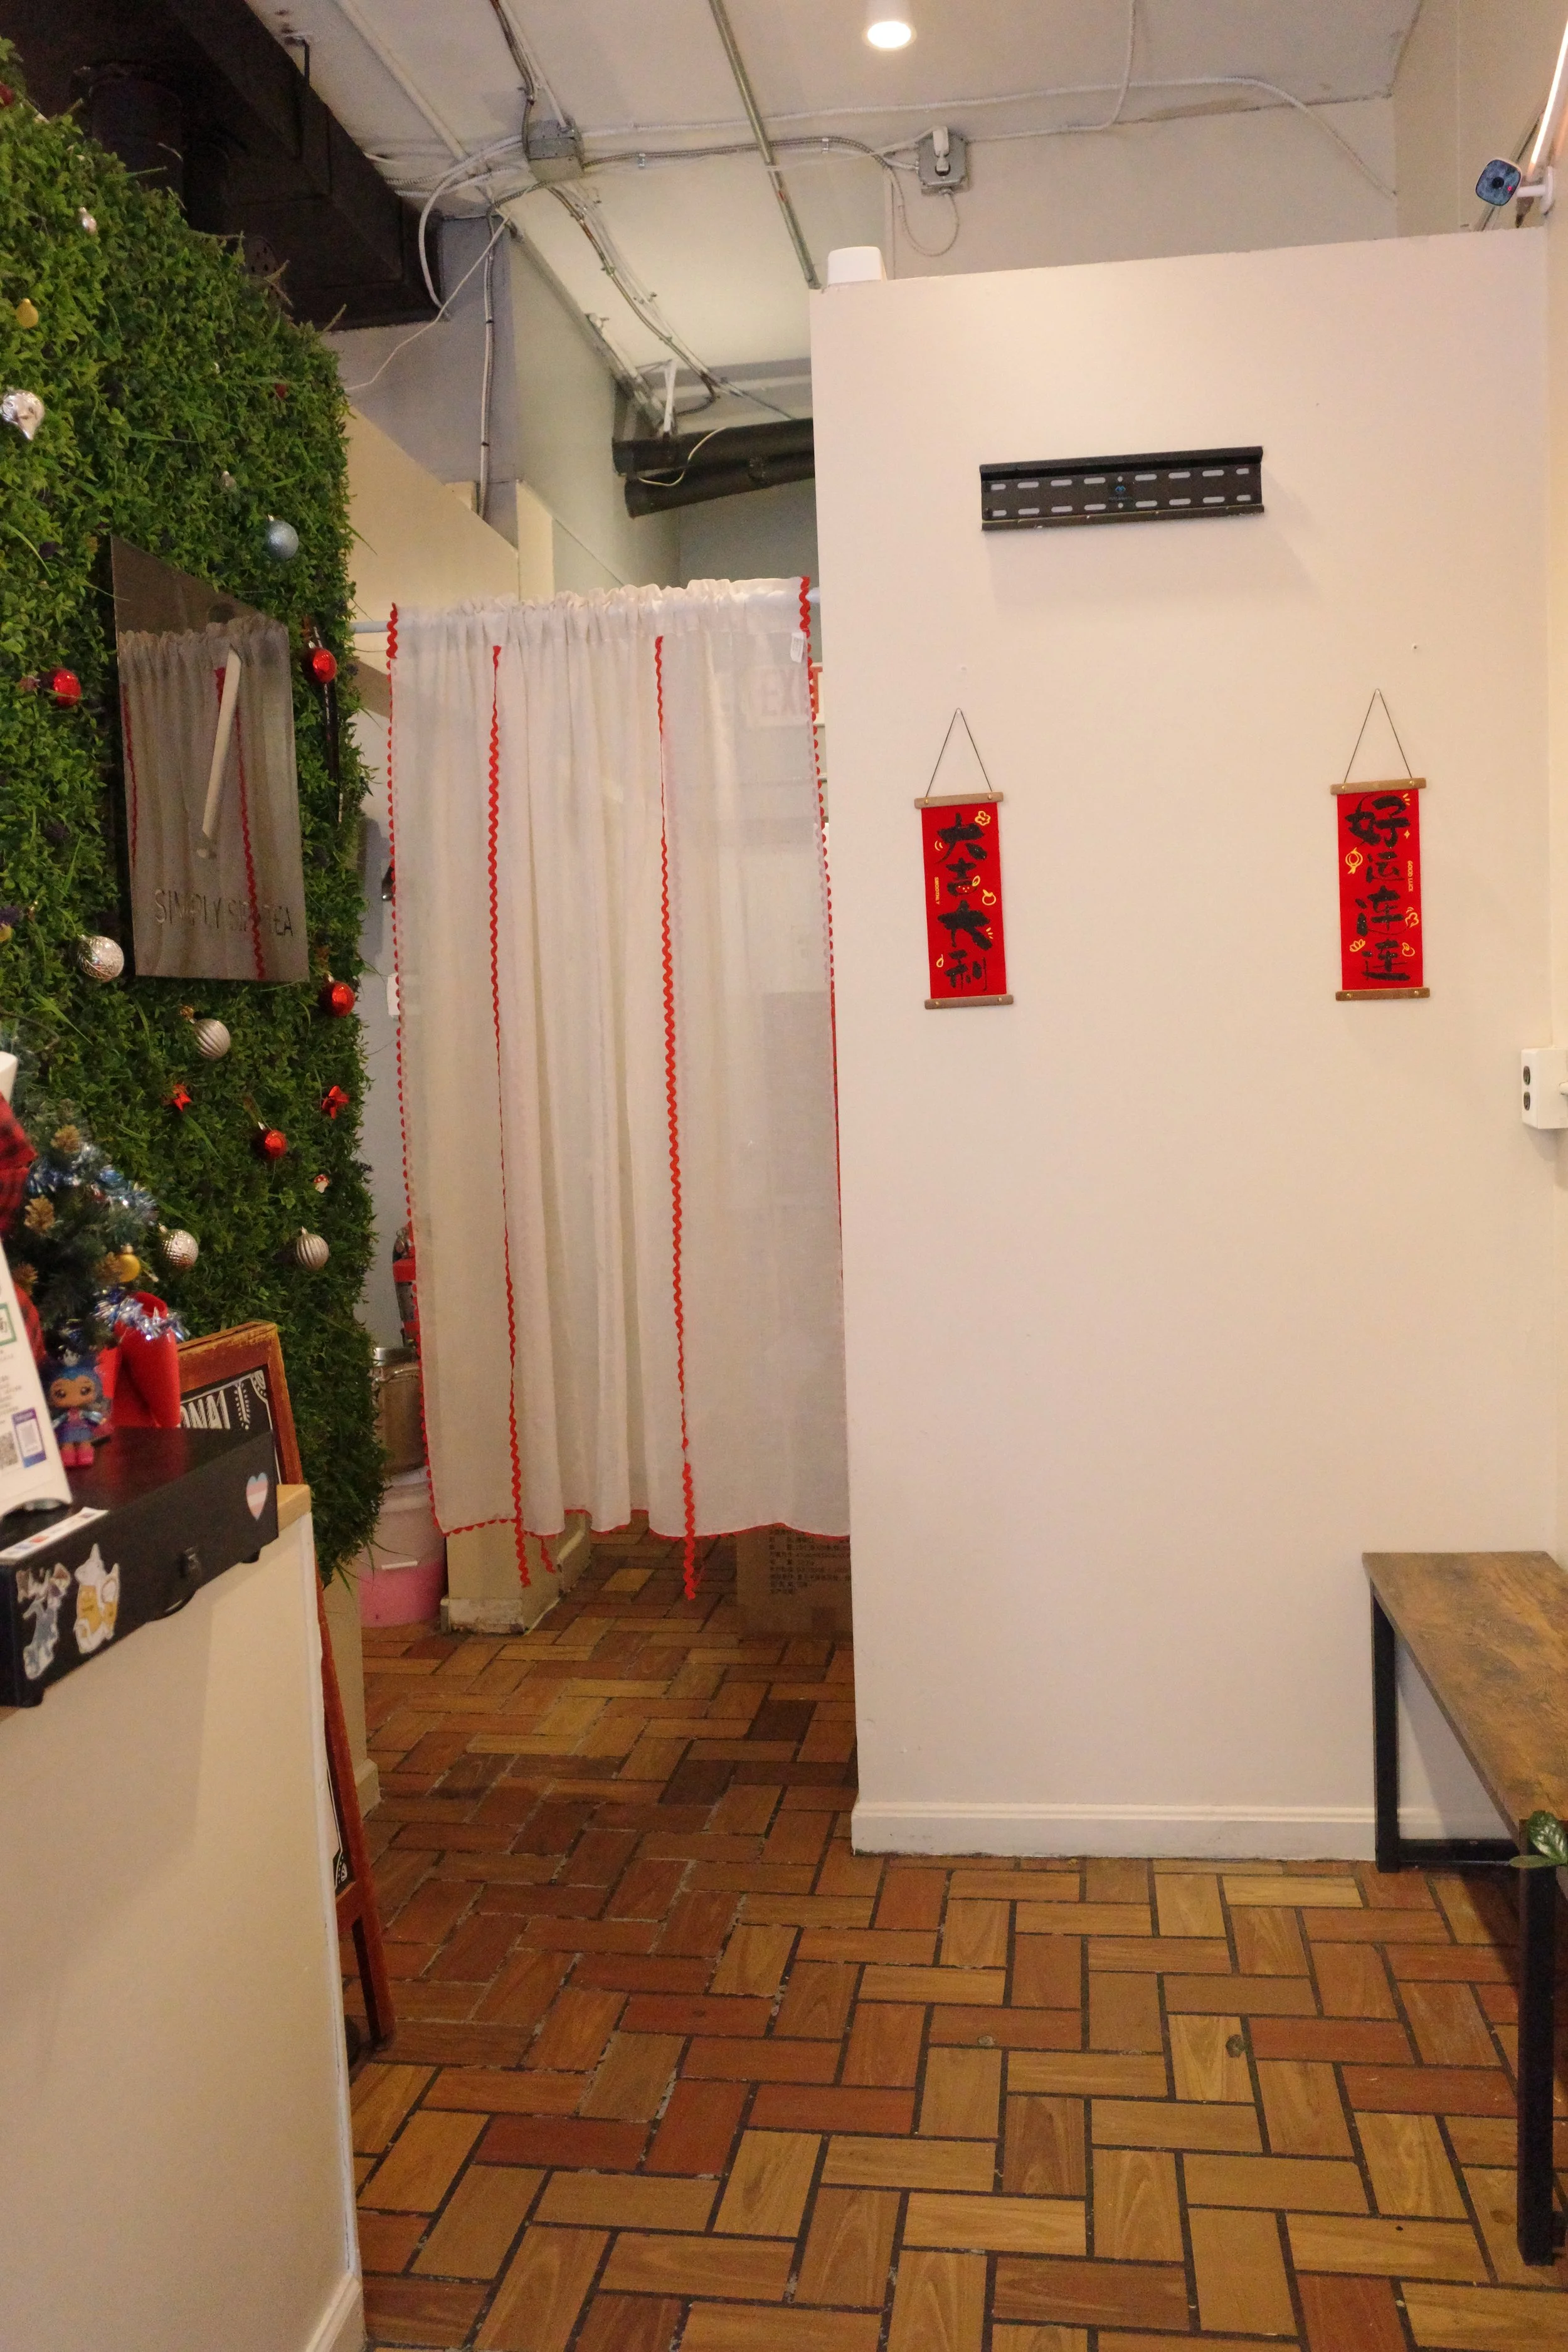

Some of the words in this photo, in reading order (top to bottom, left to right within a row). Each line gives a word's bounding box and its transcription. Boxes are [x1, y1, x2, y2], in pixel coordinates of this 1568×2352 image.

[936, 812, 993, 992] 大吉大利
[1345, 793, 1411, 982] 好运连连
